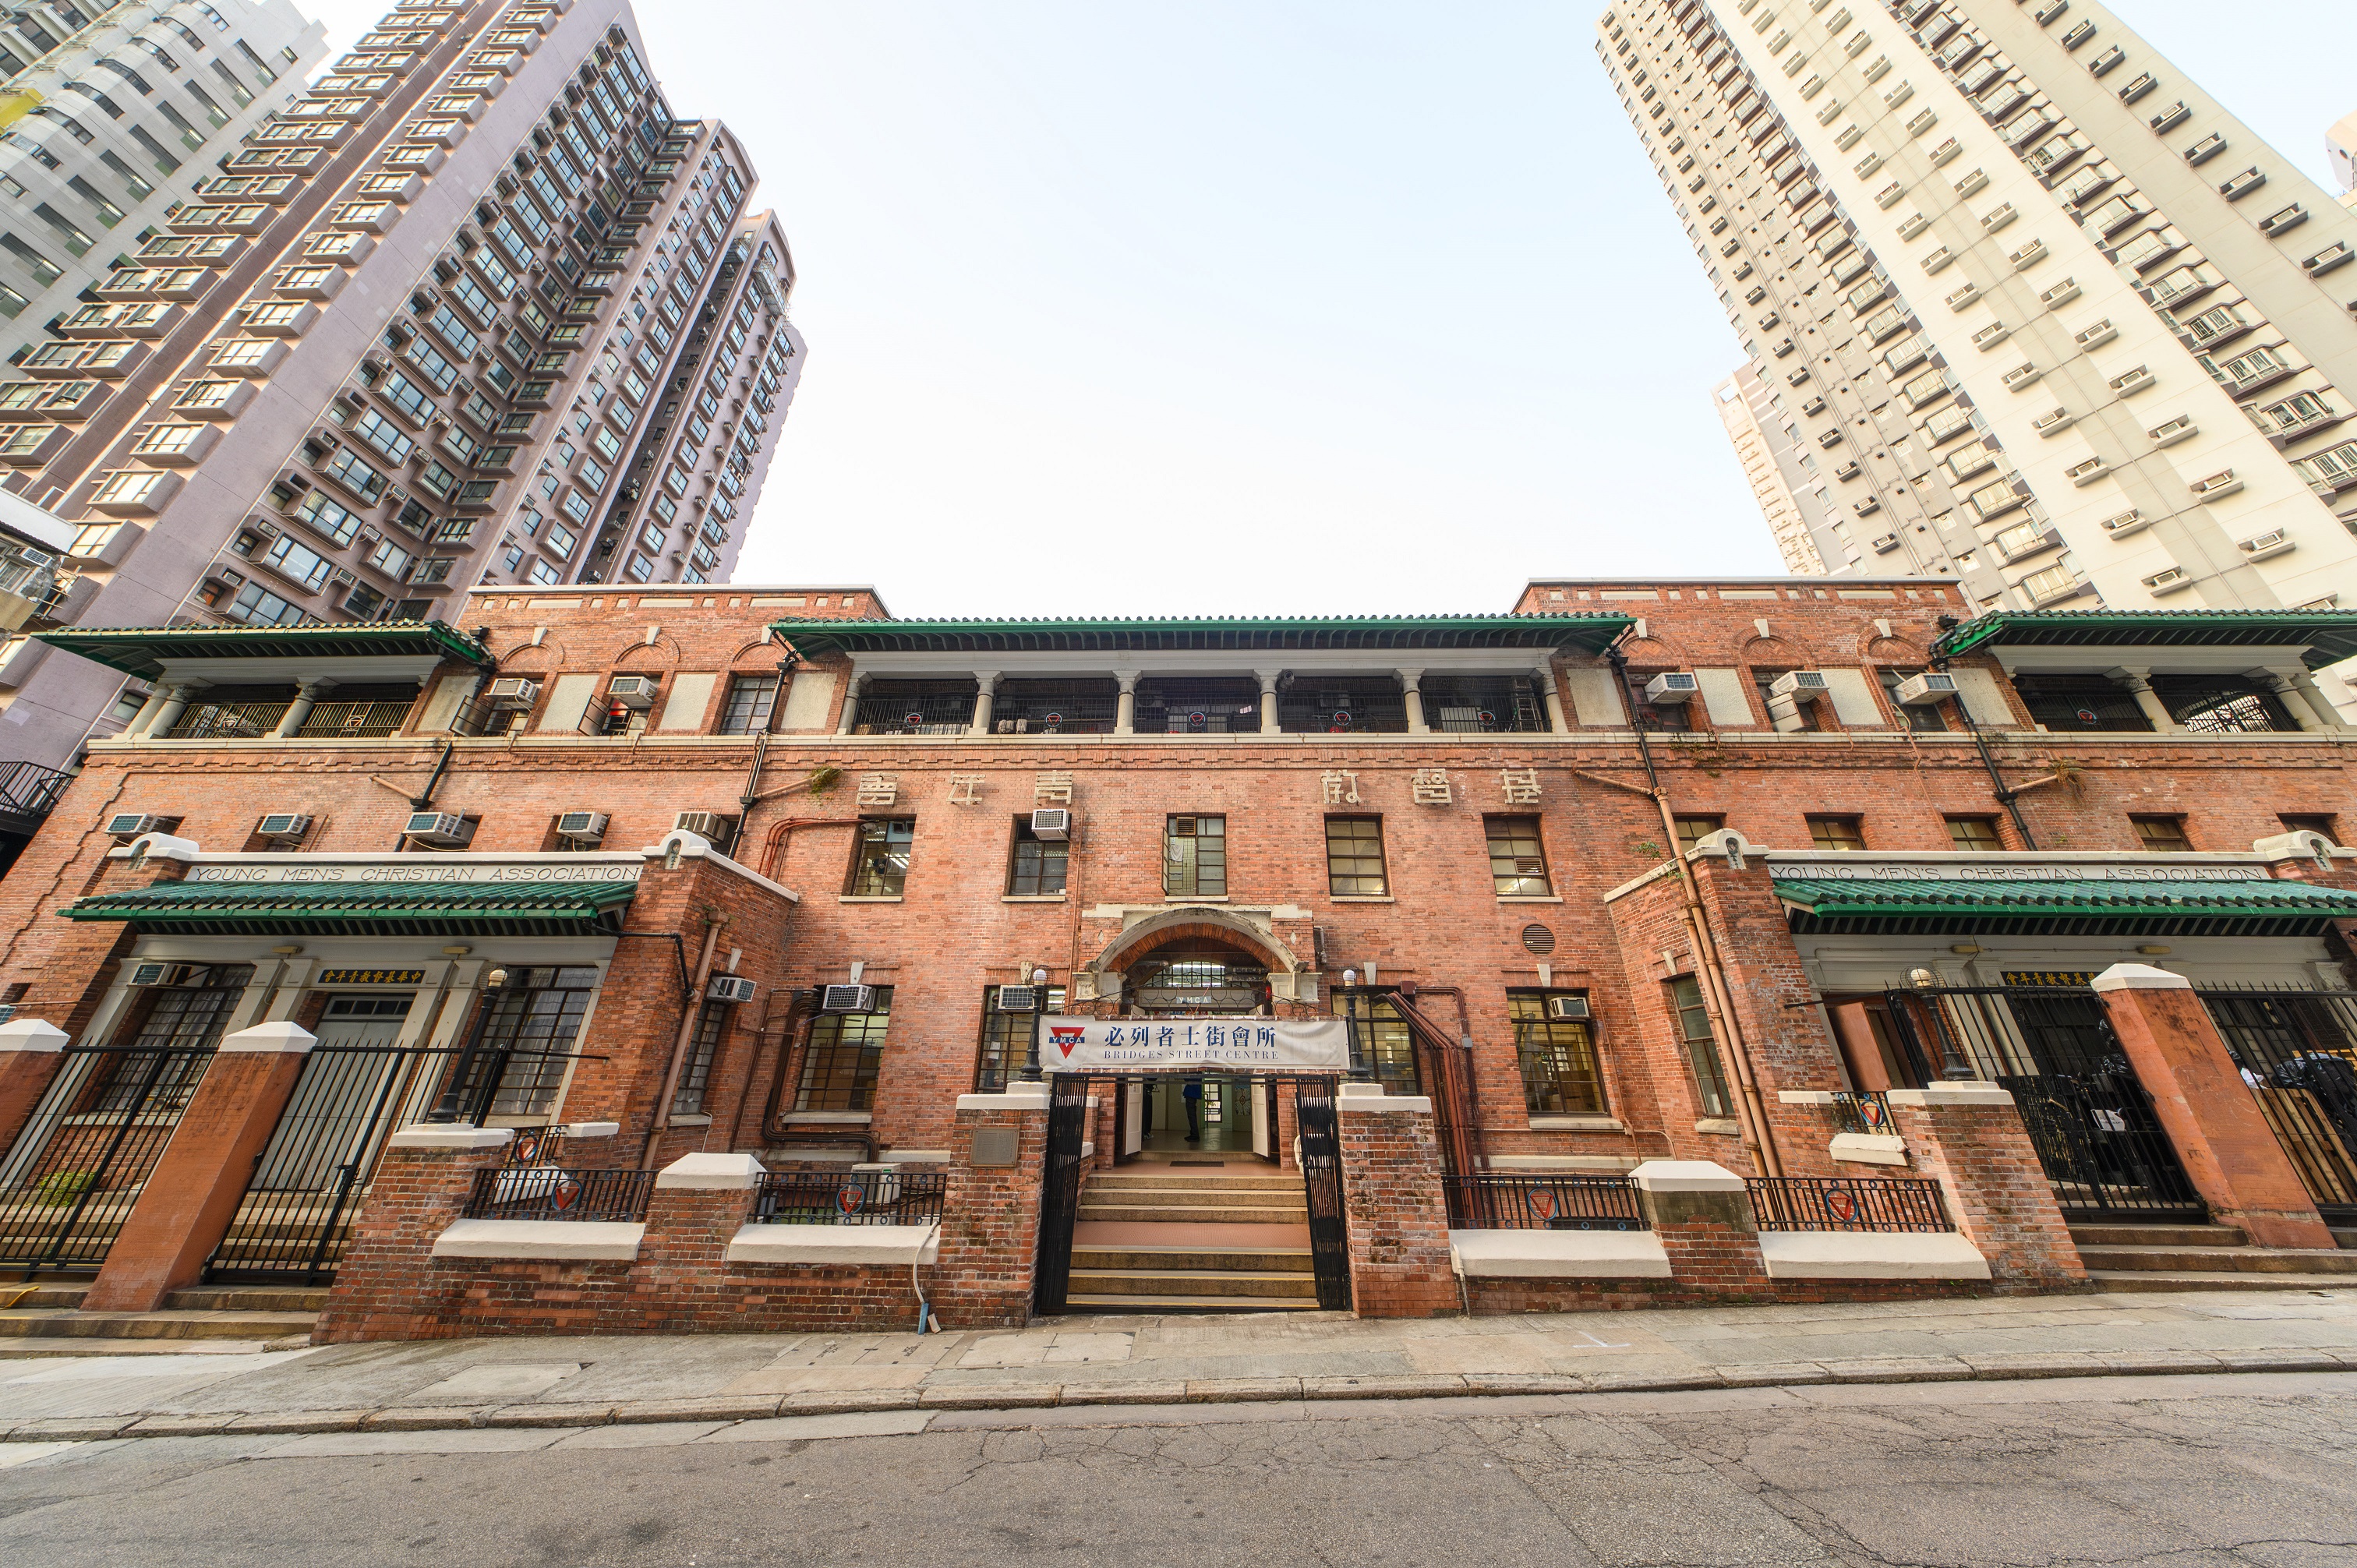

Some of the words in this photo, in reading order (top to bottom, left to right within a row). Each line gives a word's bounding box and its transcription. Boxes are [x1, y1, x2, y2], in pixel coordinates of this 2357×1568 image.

[196, 868, 268, 881] YOUNG
[281, 868, 345, 881] MEN'S
[360, 868, 476, 881] CHRISTIAN
[489, 867, 640, 881] ASSOCIATION
[1770, 867, 1855, 880] YOUNG
[1871, 867, 1942, 880] MEN'S
[1959, 867, 2083, 880] CHRISTIAN
[2104, 867, 2263, 880] ASSOCIATION
[1104, 1026, 1277, 1047] 必列者士街會所
[1104, 1050, 1163, 1059] BRIDGES
[1168, 1050, 1220, 1059] STREET
[1225, 1050, 1278, 1059] CENTRE
